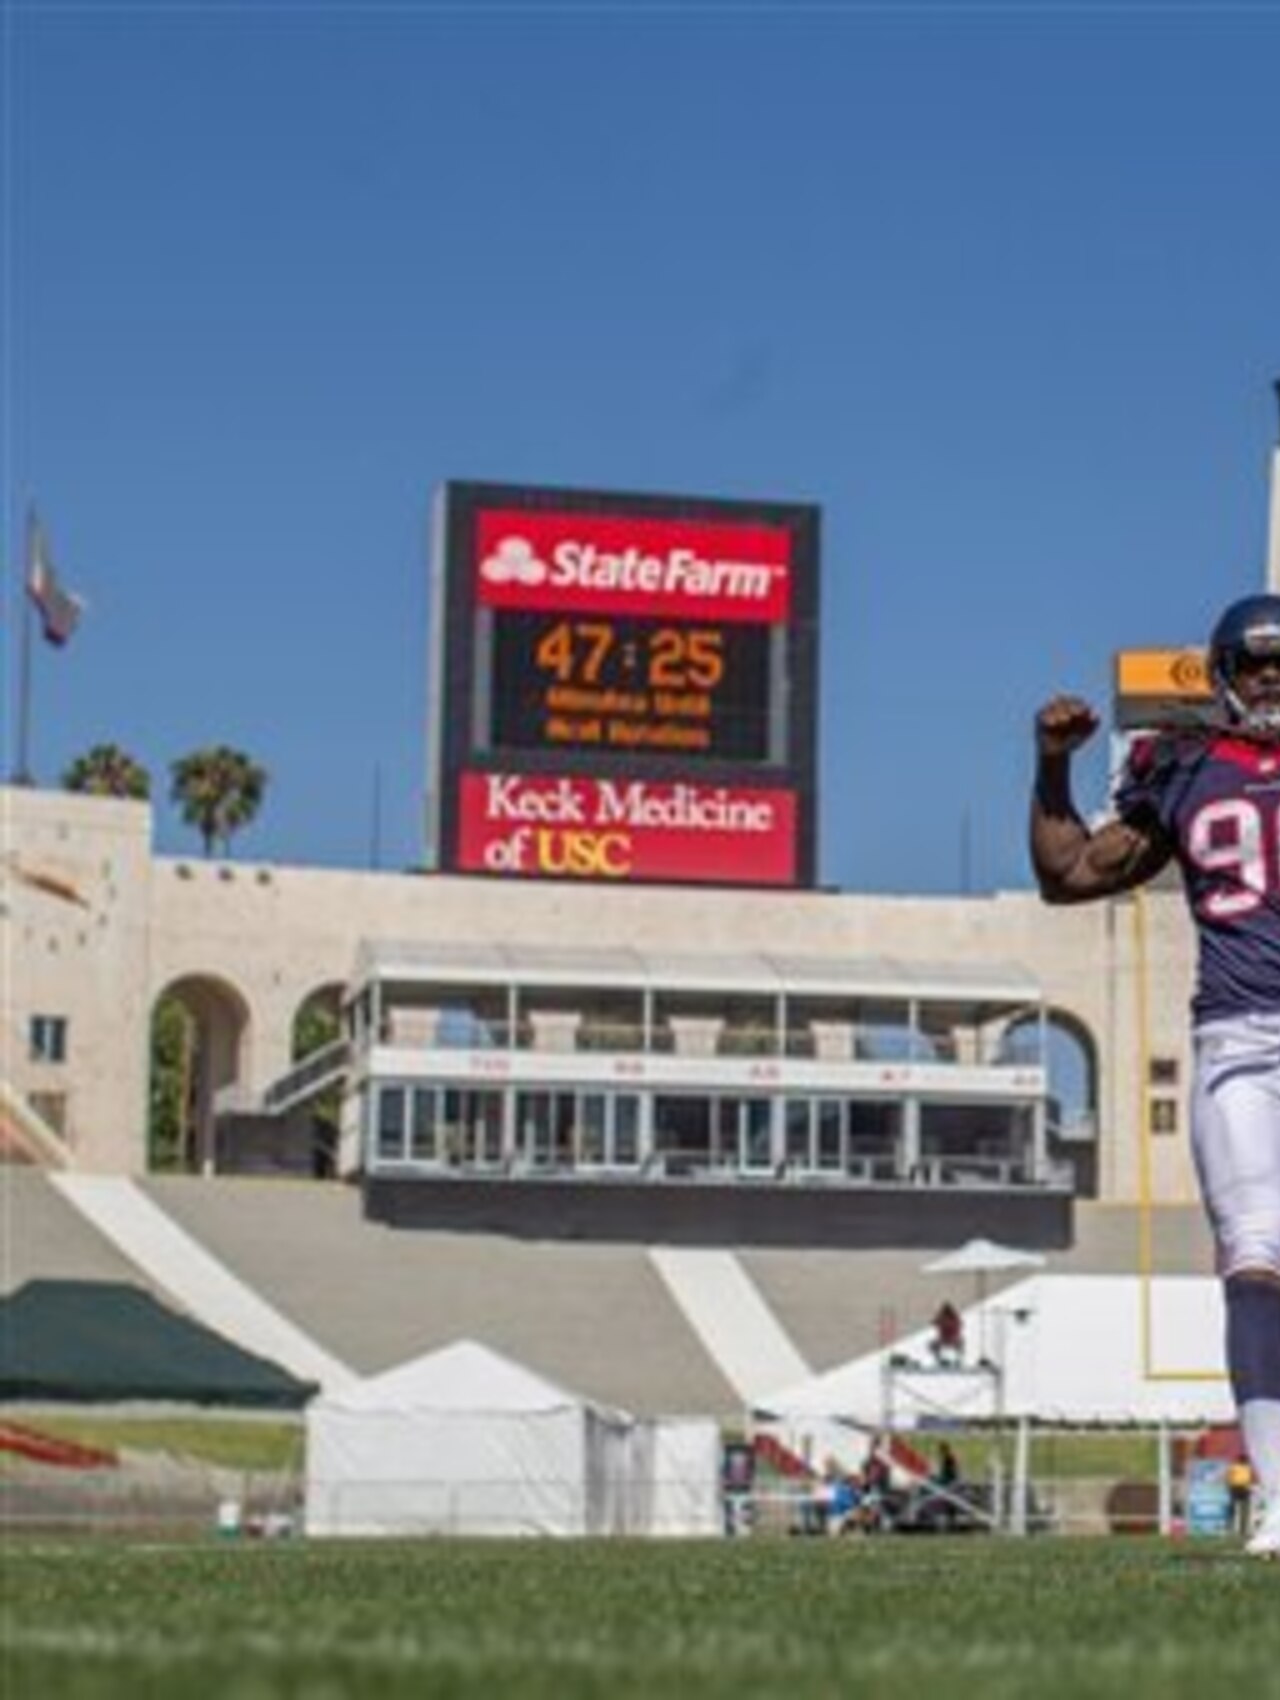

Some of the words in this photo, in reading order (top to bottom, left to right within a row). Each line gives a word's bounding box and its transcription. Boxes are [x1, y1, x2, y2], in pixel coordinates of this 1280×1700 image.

[485, 774, 585, 822] Keck
[595, 778, 774, 831] Medicine
[484, 826, 531, 871] of
[537, 827, 632, 876] USC
